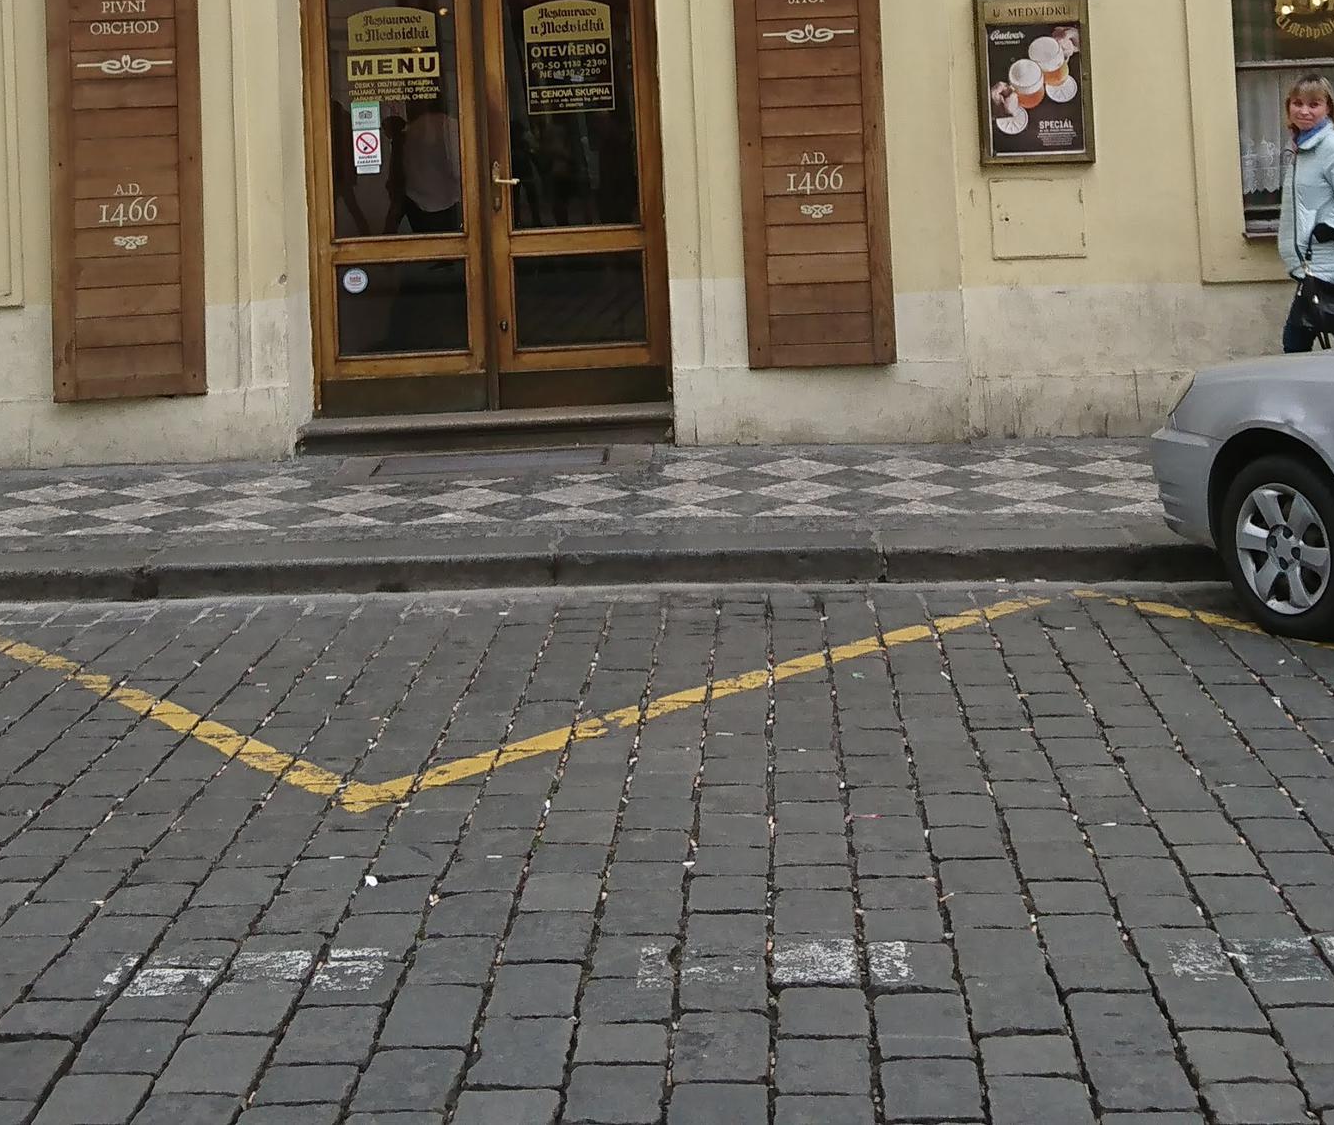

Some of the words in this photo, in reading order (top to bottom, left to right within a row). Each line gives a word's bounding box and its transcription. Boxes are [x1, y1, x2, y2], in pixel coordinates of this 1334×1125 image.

[90, 20, 160, 35] OBCHOD
[531, 43, 606, 57] OTEVŘENO
[351, 56, 436, 76] MENU
[800, 152, 828, 165] A.D.
[786, 165, 844, 195] 1466
[114, 183, 142, 196] A.D.
[99, 196, 158, 227] 1466
